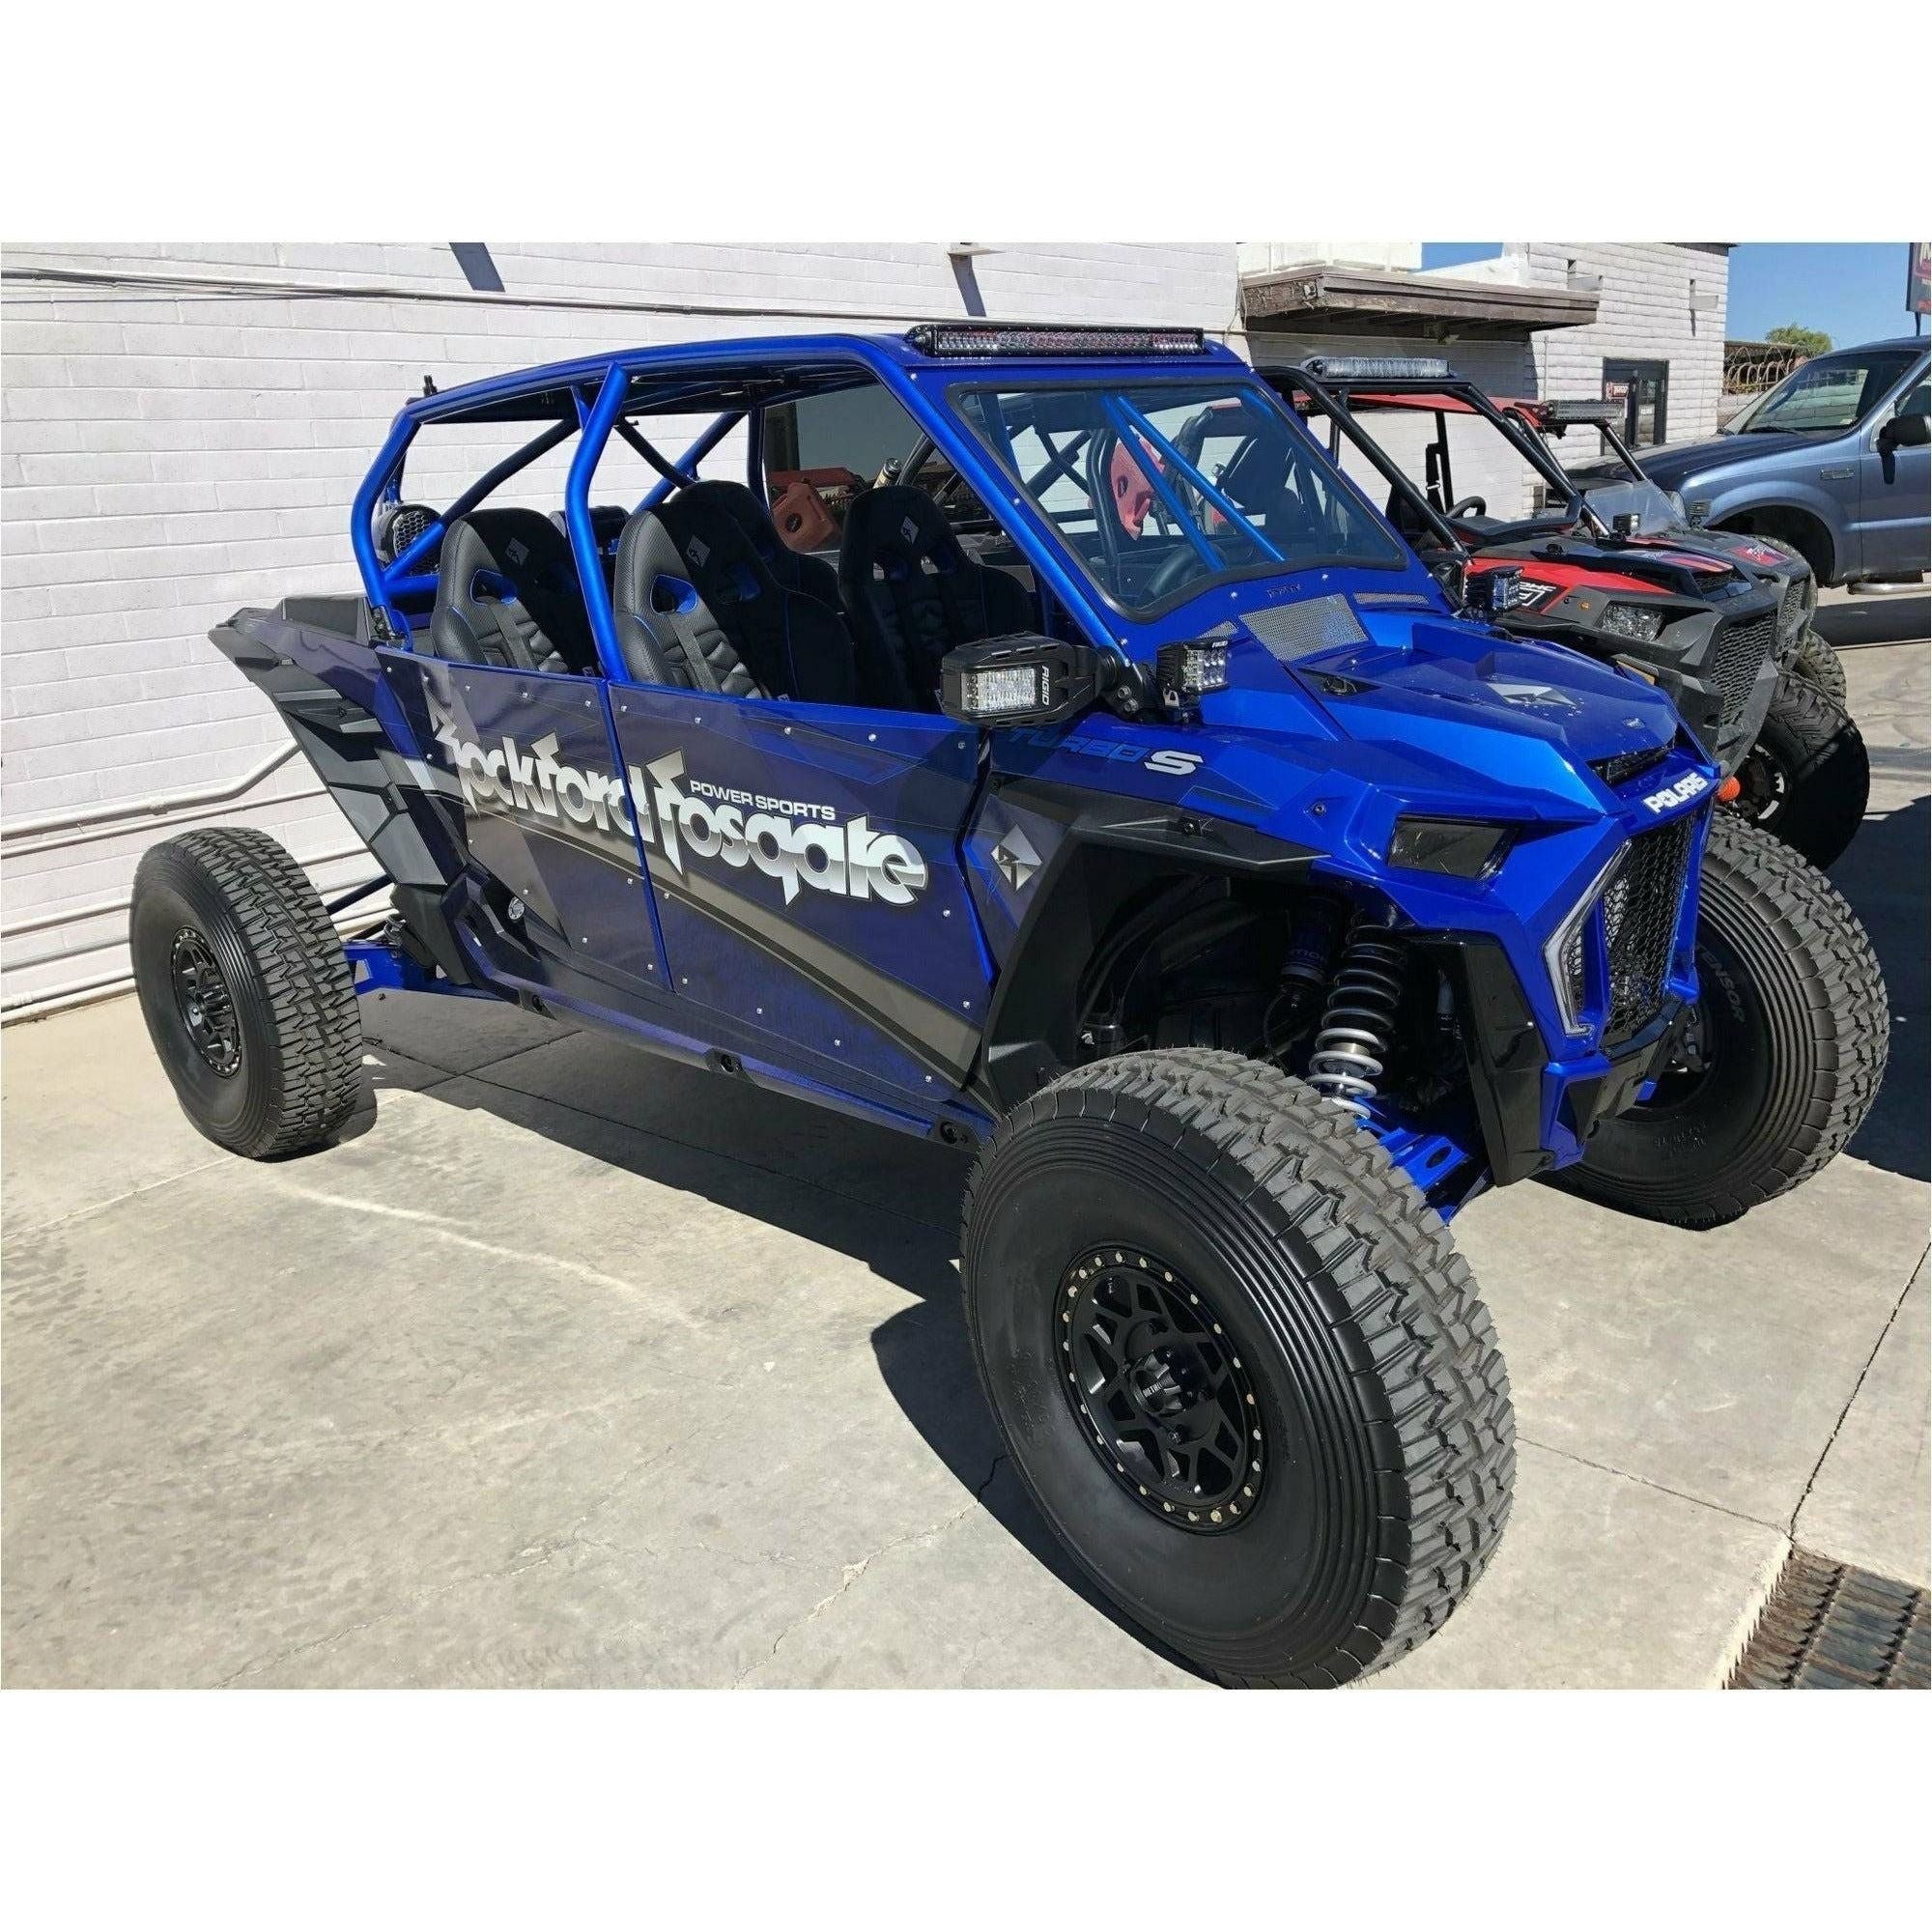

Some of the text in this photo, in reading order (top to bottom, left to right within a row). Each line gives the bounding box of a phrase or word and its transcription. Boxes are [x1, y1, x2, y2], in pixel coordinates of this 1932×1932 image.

[1143, 750, 1205, 776] S
[690, 780, 837, 821] POWER SPORTS
[1643, 772, 1709, 813] POLARIS
